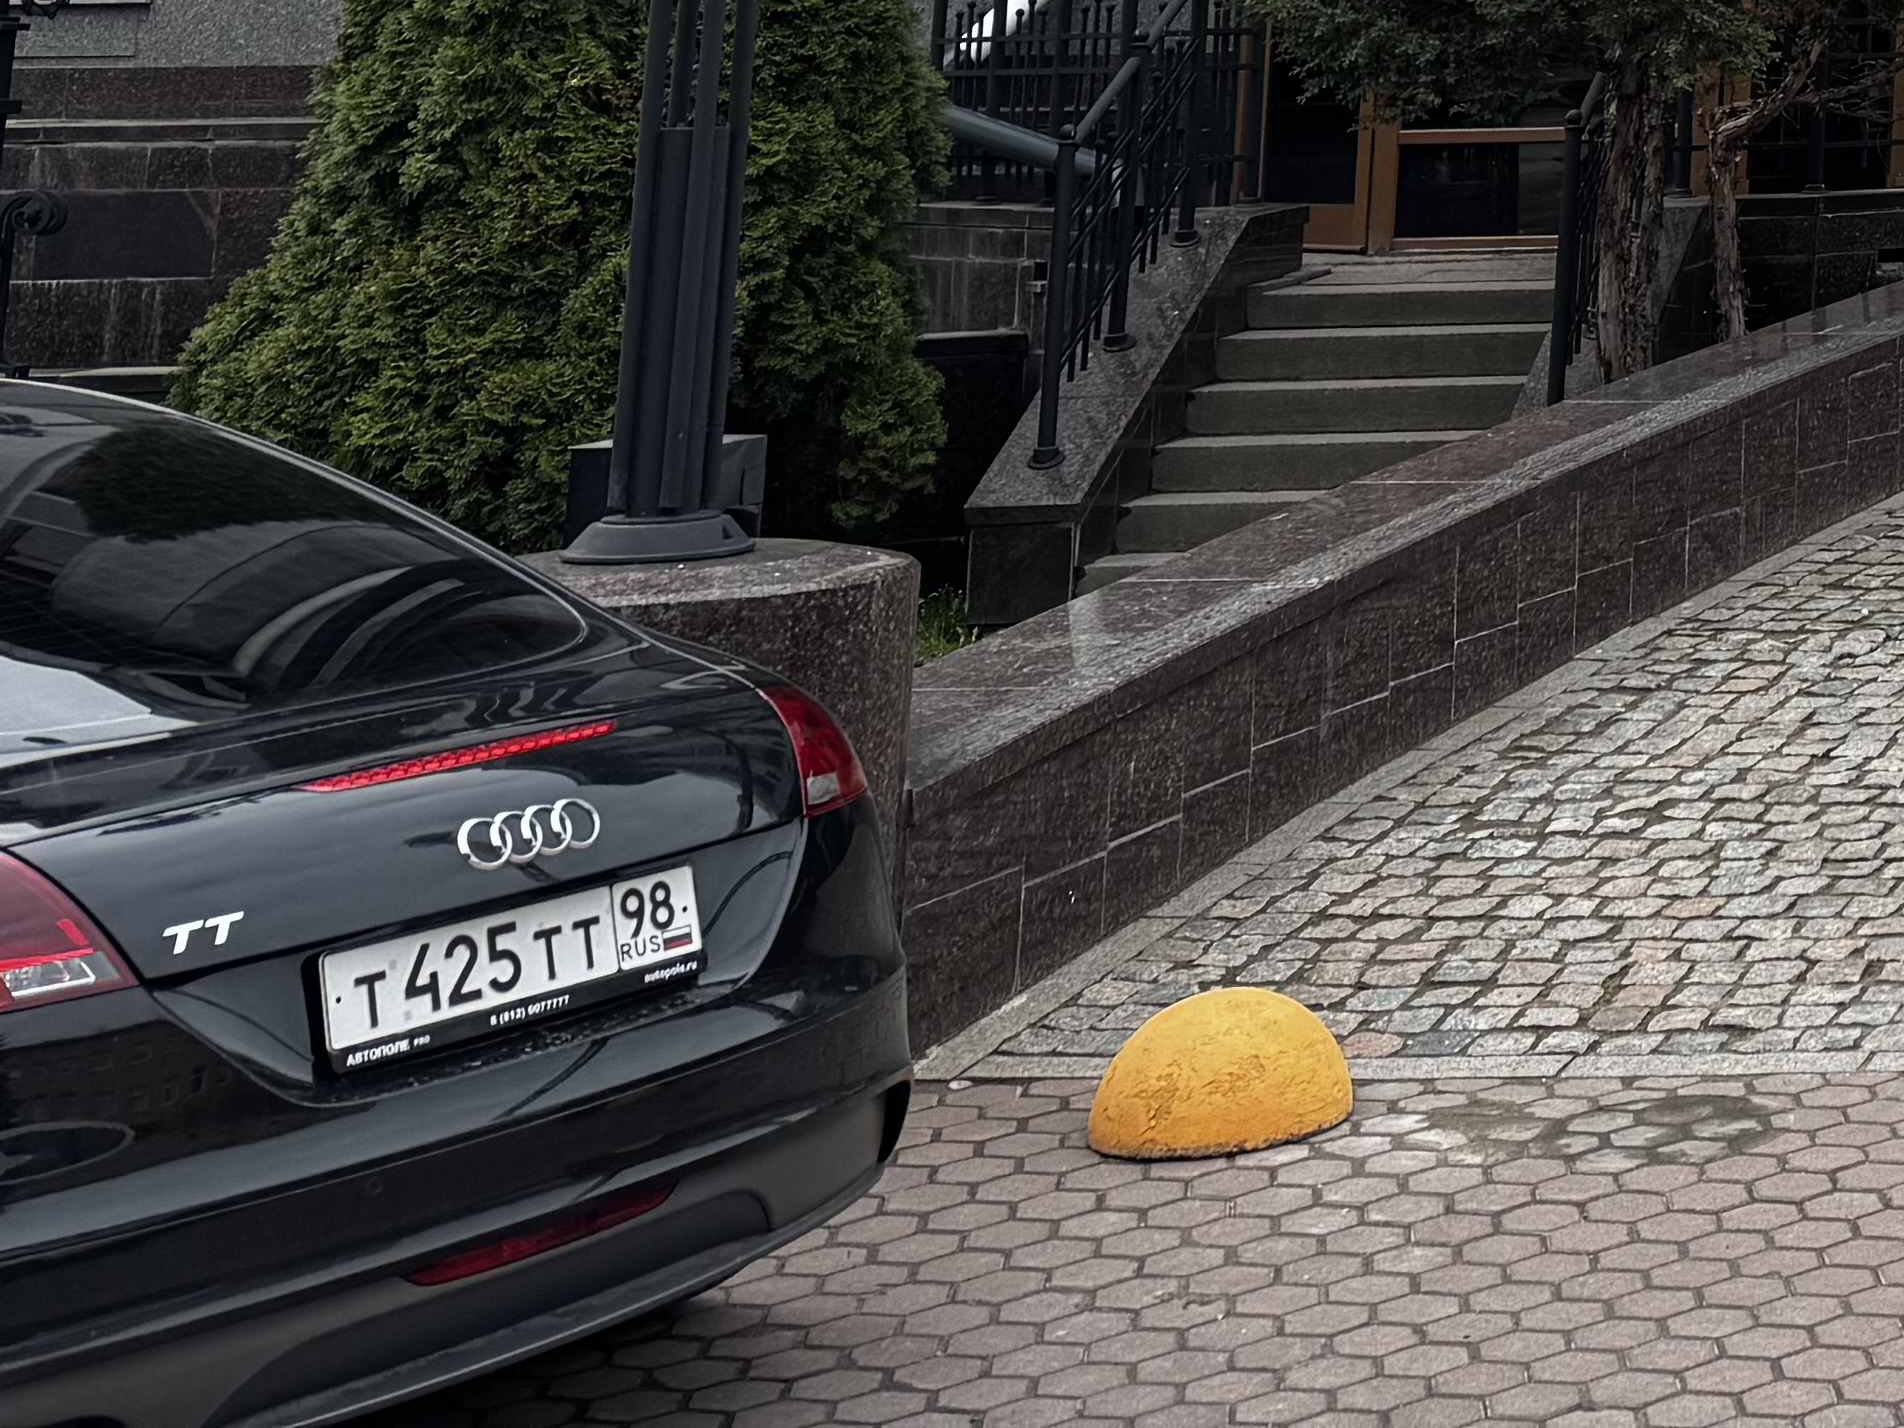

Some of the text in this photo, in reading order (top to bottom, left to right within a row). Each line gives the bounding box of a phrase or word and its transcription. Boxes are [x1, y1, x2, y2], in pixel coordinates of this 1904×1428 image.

[619, 881, 676, 940] 98
[162, 911, 245, 955] TT
[620, 935, 661, 962] RUS
